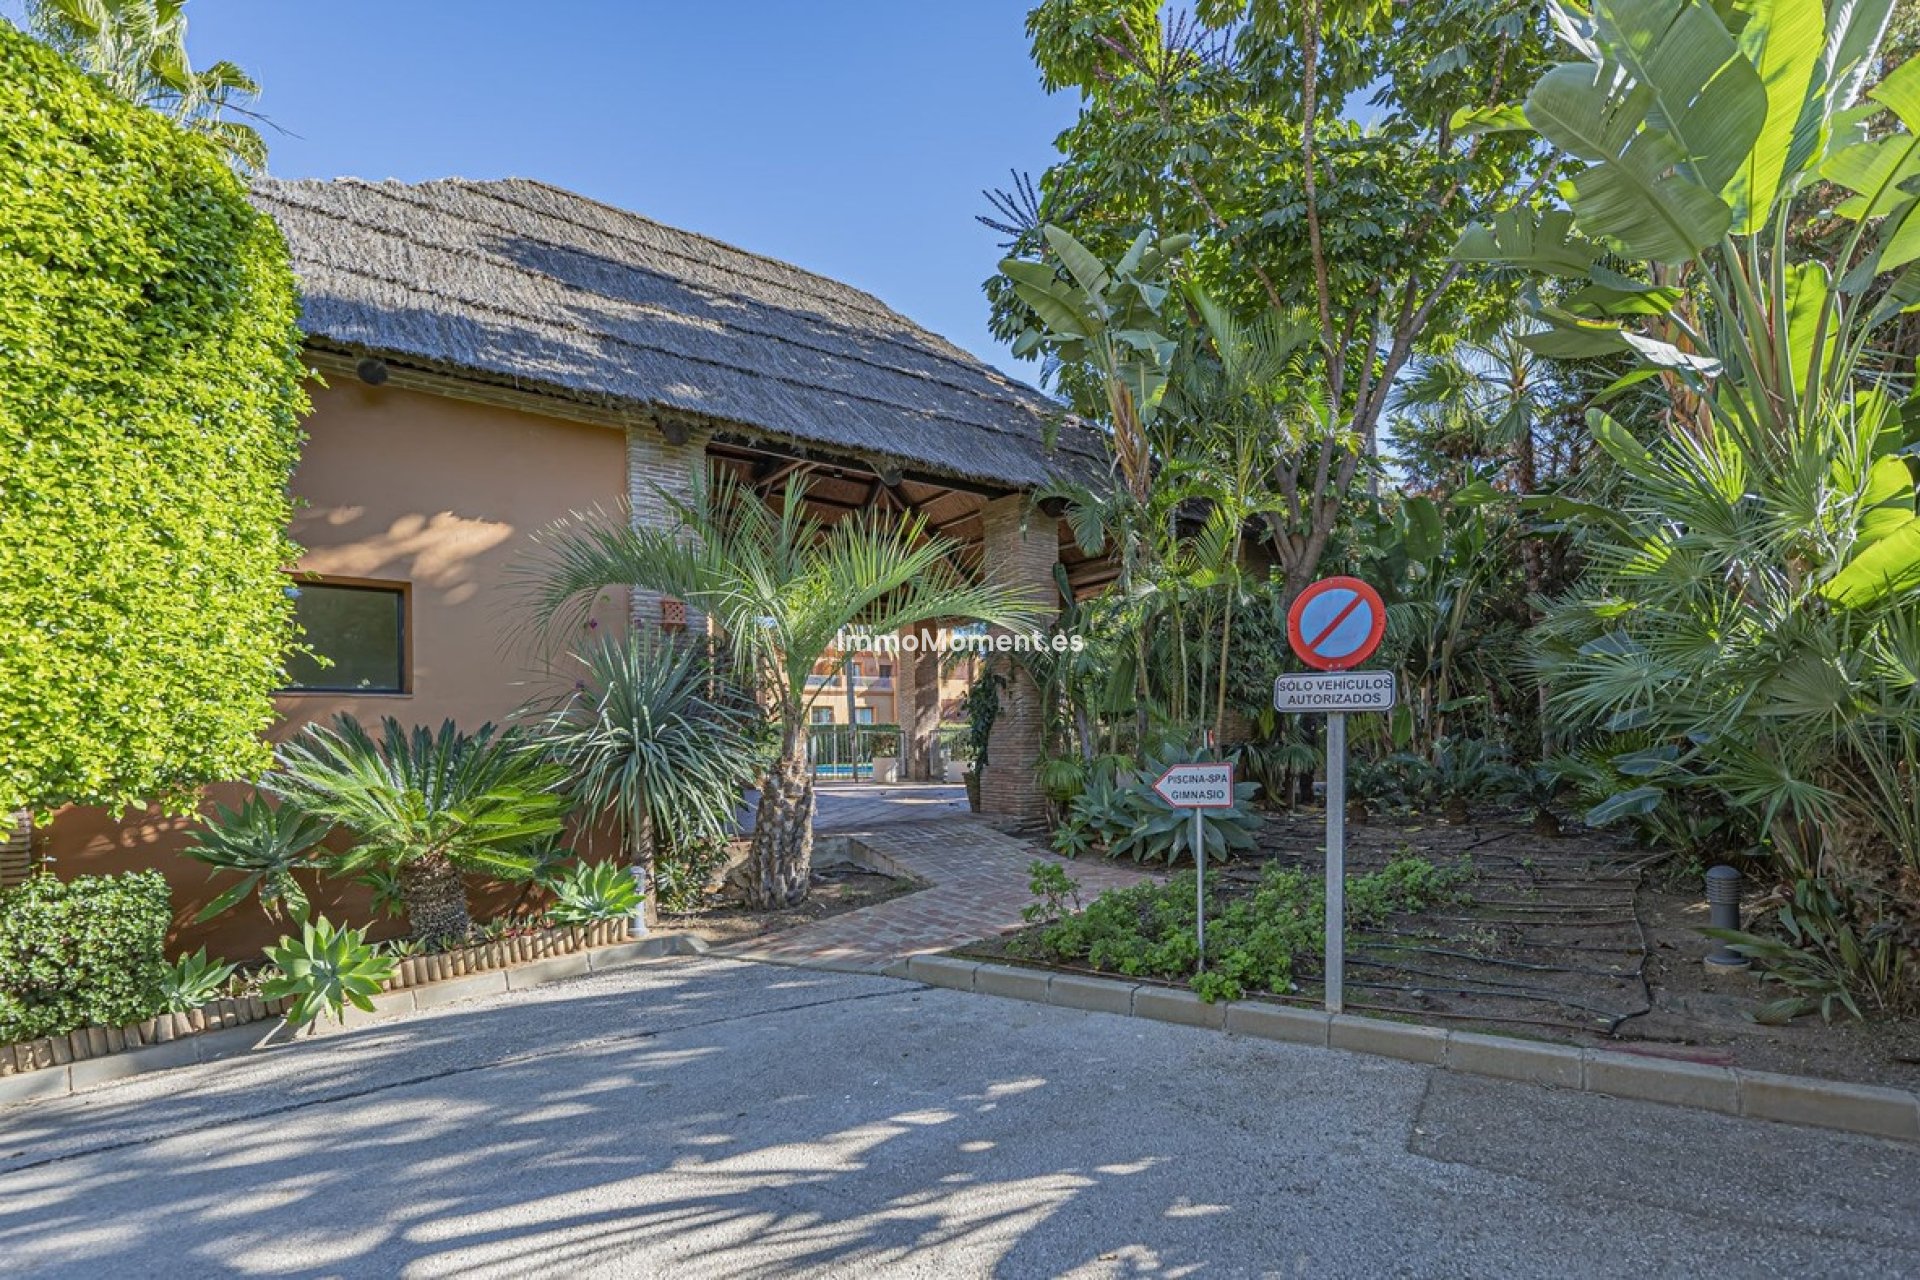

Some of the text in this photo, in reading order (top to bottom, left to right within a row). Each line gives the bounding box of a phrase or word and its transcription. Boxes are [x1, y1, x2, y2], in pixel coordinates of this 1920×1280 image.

[1288, 693, 1381, 705] AUTORIZADOS
[1167, 774, 1228, 784] PISCINA-SPA
[1171, 790, 1226, 800] GIMNASIO
